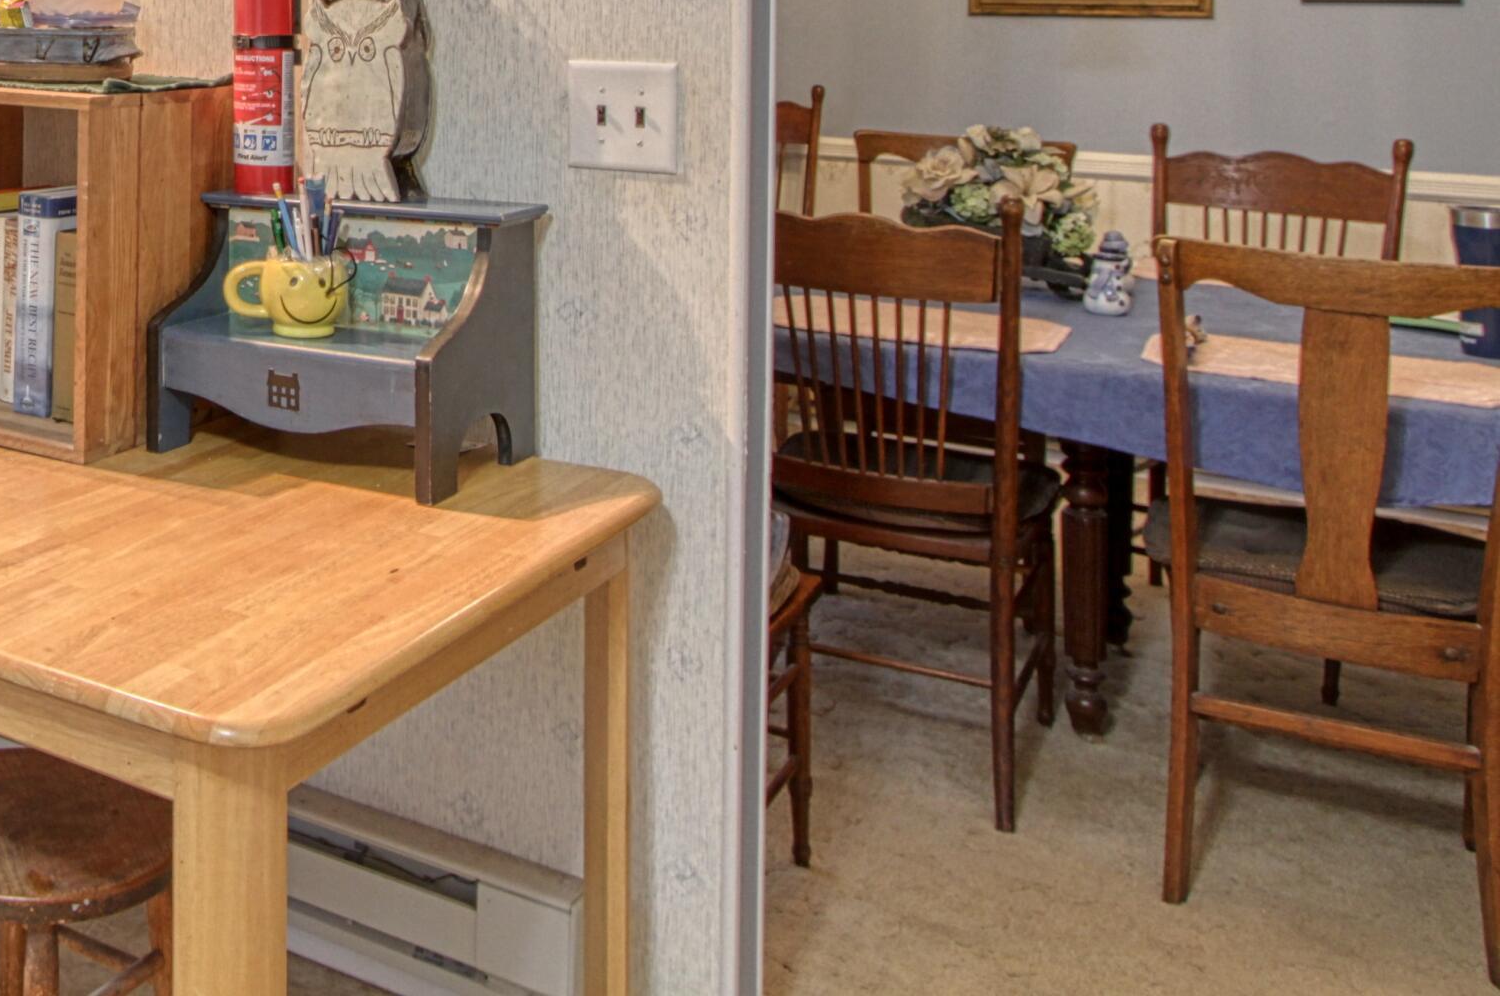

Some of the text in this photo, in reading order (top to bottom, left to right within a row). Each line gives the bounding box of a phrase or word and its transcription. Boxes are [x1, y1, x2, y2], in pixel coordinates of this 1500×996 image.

[4, 309, 13, 336] JEFF
[27, 242, 40, 381] THE NEW BEST RECIPE
[3, 339, 12, 374] SMITH
